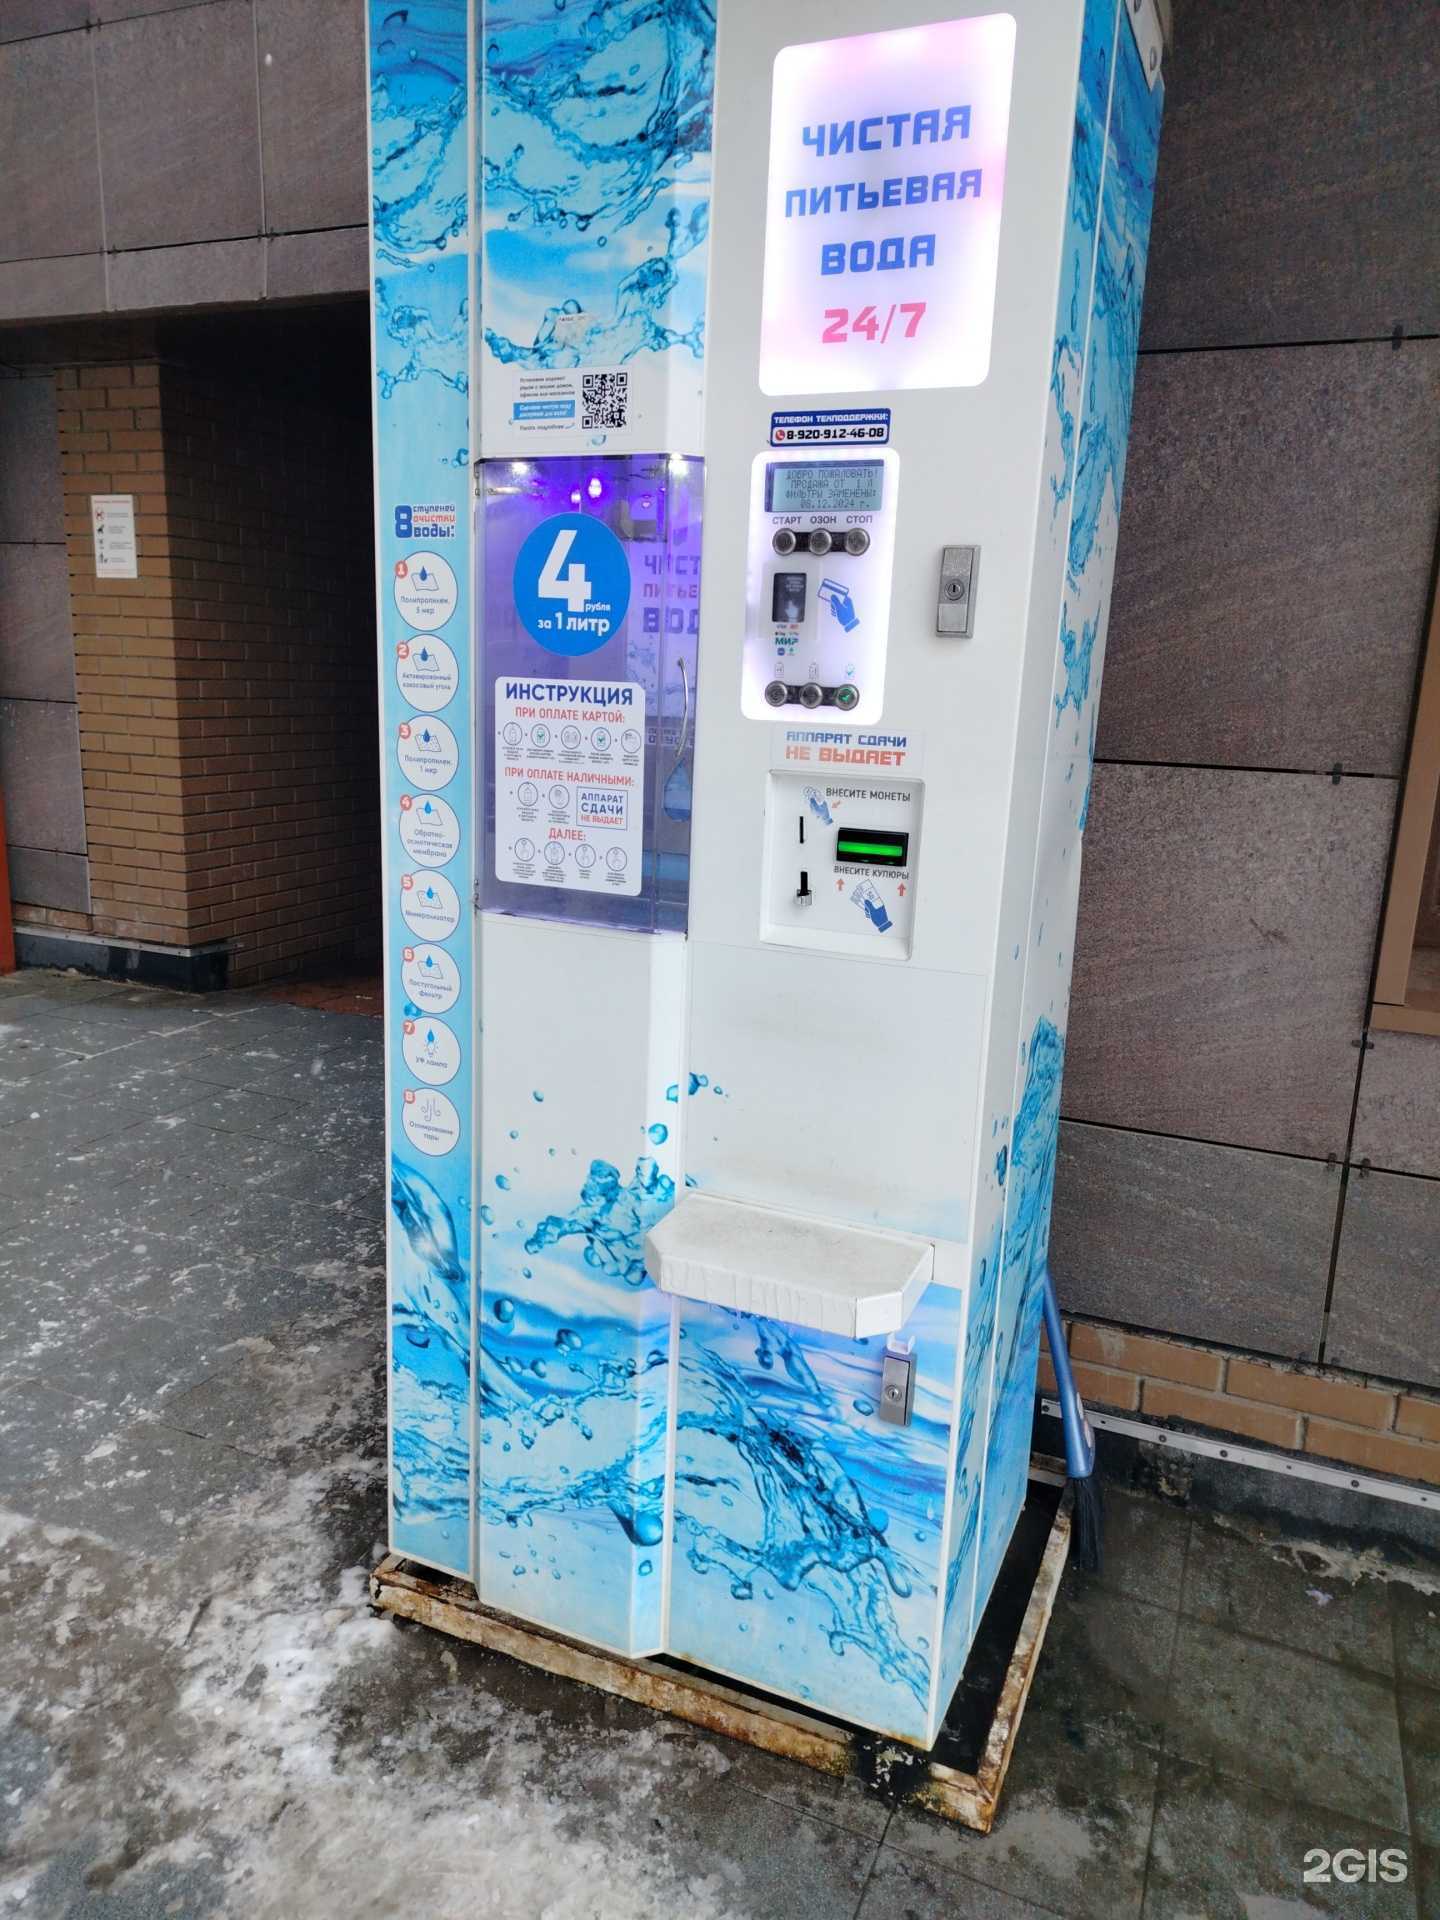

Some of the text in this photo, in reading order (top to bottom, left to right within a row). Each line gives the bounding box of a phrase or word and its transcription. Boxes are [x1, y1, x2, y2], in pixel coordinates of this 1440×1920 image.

[802, 105, 971, 157] ЧИСТАЯ
[785, 169, 983, 217] ПИТЬЕВАЯ
[821, 234, 936, 275] ВОДА
[822, 302, 927, 344] 24/7
[775, 415, 813, 424] ТЕЛЕФОН
[787, 427, 884, 440] 8-920-912-46-08
[413, 505, 455, 513] ступеней
[395, 505, 412, 538] 8
[413, 514, 455, 523] очистки
[772, 515, 873, 525] СТАРТ ОЗОН СТОП
[414, 524, 455, 538] воды:
[538, 529, 592, 612] 4
[585, 602, 611, 612] рубля
[537, 612, 610, 637] за 1 литр
[398, 643, 407, 655] 2
[506, 682, 633, 707] ИНСТРУКЦИЯ
[515, 707, 625, 723] ПРИ ОПЛАТЕ КАРТОЙ:
[786, 731, 907, 747] АППАРАТ СДАЧИ
[785, 746, 906, 766] НЕ ВЫДАЕТ
[505, 767, 635, 786] ПРИ ОПЛАТЕ НАЛИЧНЫМИ:
[581, 793, 624, 804] АППАРАТ
[826, 787, 911, 802] ВНЕСИТЕ МОНЕТЫ
[581, 802, 623, 815] СДАЧИ
[549, 828, 586, 841] ДАЛЕЕ:
[834, 865, 909, 880] ВНЕСИТЕ КУПЮРЫ
